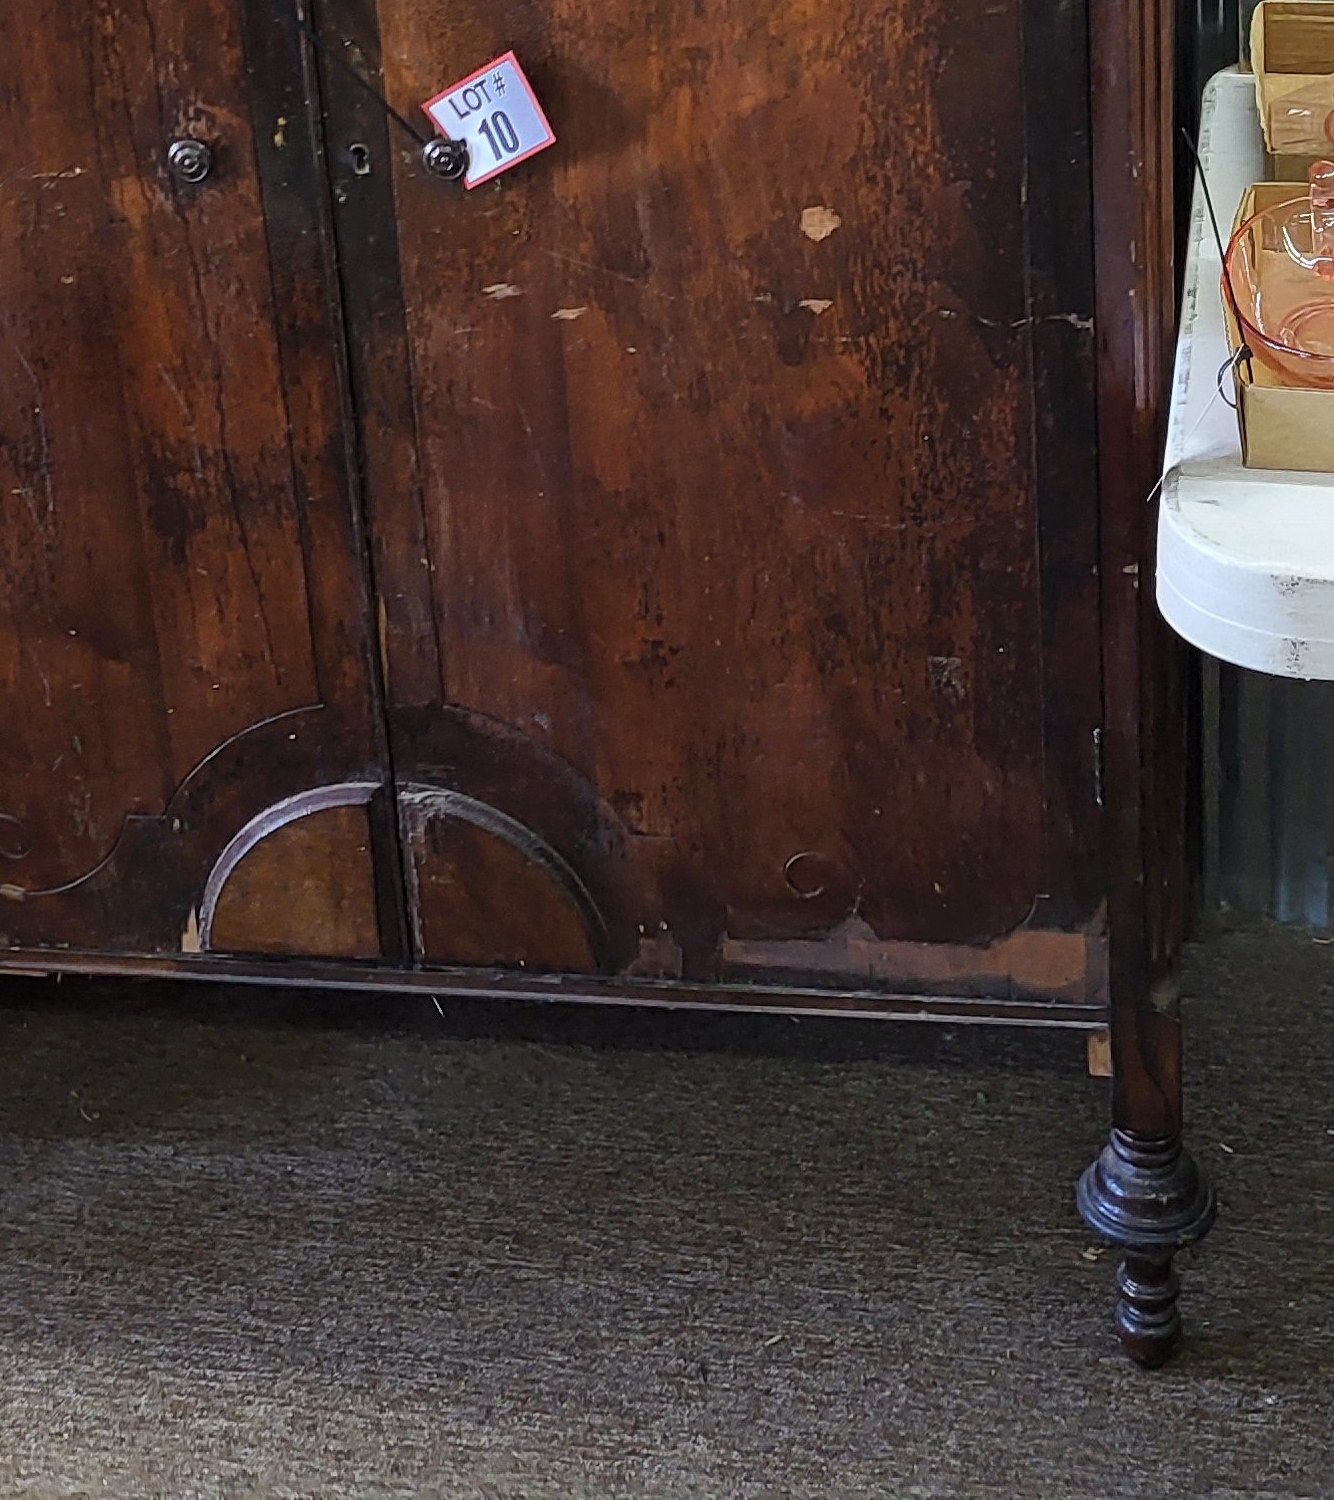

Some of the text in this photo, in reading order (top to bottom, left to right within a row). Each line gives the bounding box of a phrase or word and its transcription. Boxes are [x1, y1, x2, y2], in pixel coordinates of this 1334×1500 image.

[448, 71, 507, 120] LOT #
[478, 110, 520, 162] 10
